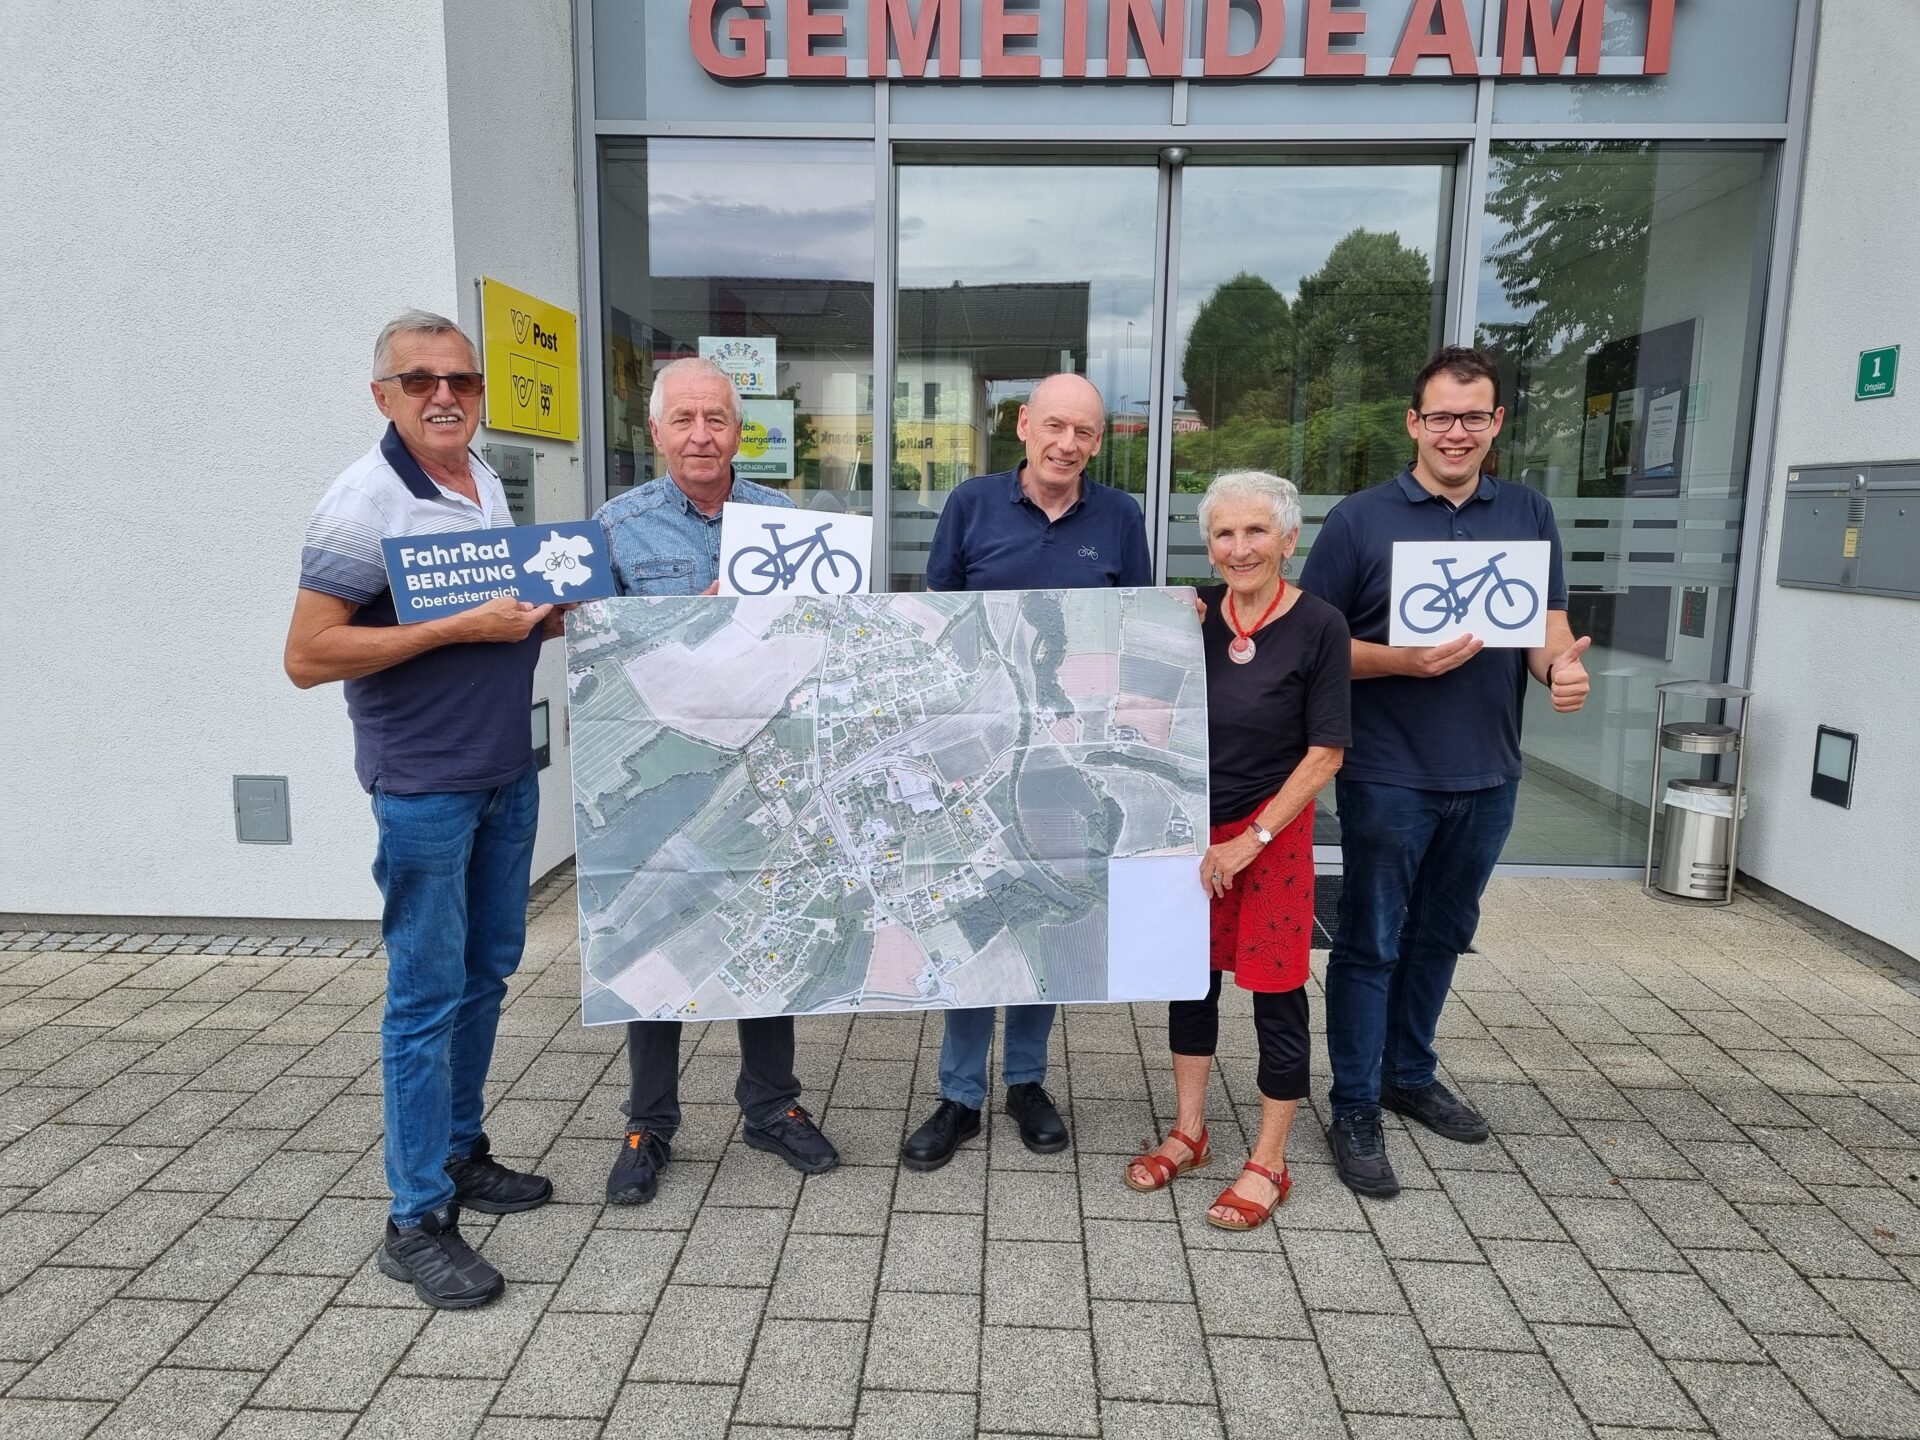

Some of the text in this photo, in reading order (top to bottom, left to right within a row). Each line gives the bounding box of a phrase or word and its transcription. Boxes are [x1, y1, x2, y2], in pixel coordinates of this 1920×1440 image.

[689, 0, 1676, 78] GEMEINDEAMT
[533, 323, 558, 353] Post
[1872, 356, 1881, 377] 1
[540, 381, 553, 395] bank
[1864, 382, 1887, 392] Ortsplatz
[540, 395, 551, 417] 99
[400, 538, 510, 568] FahrRad
[405, 564, 516, 591] BERATUNG
[411, 586, 520, 609] Oberösterreich
